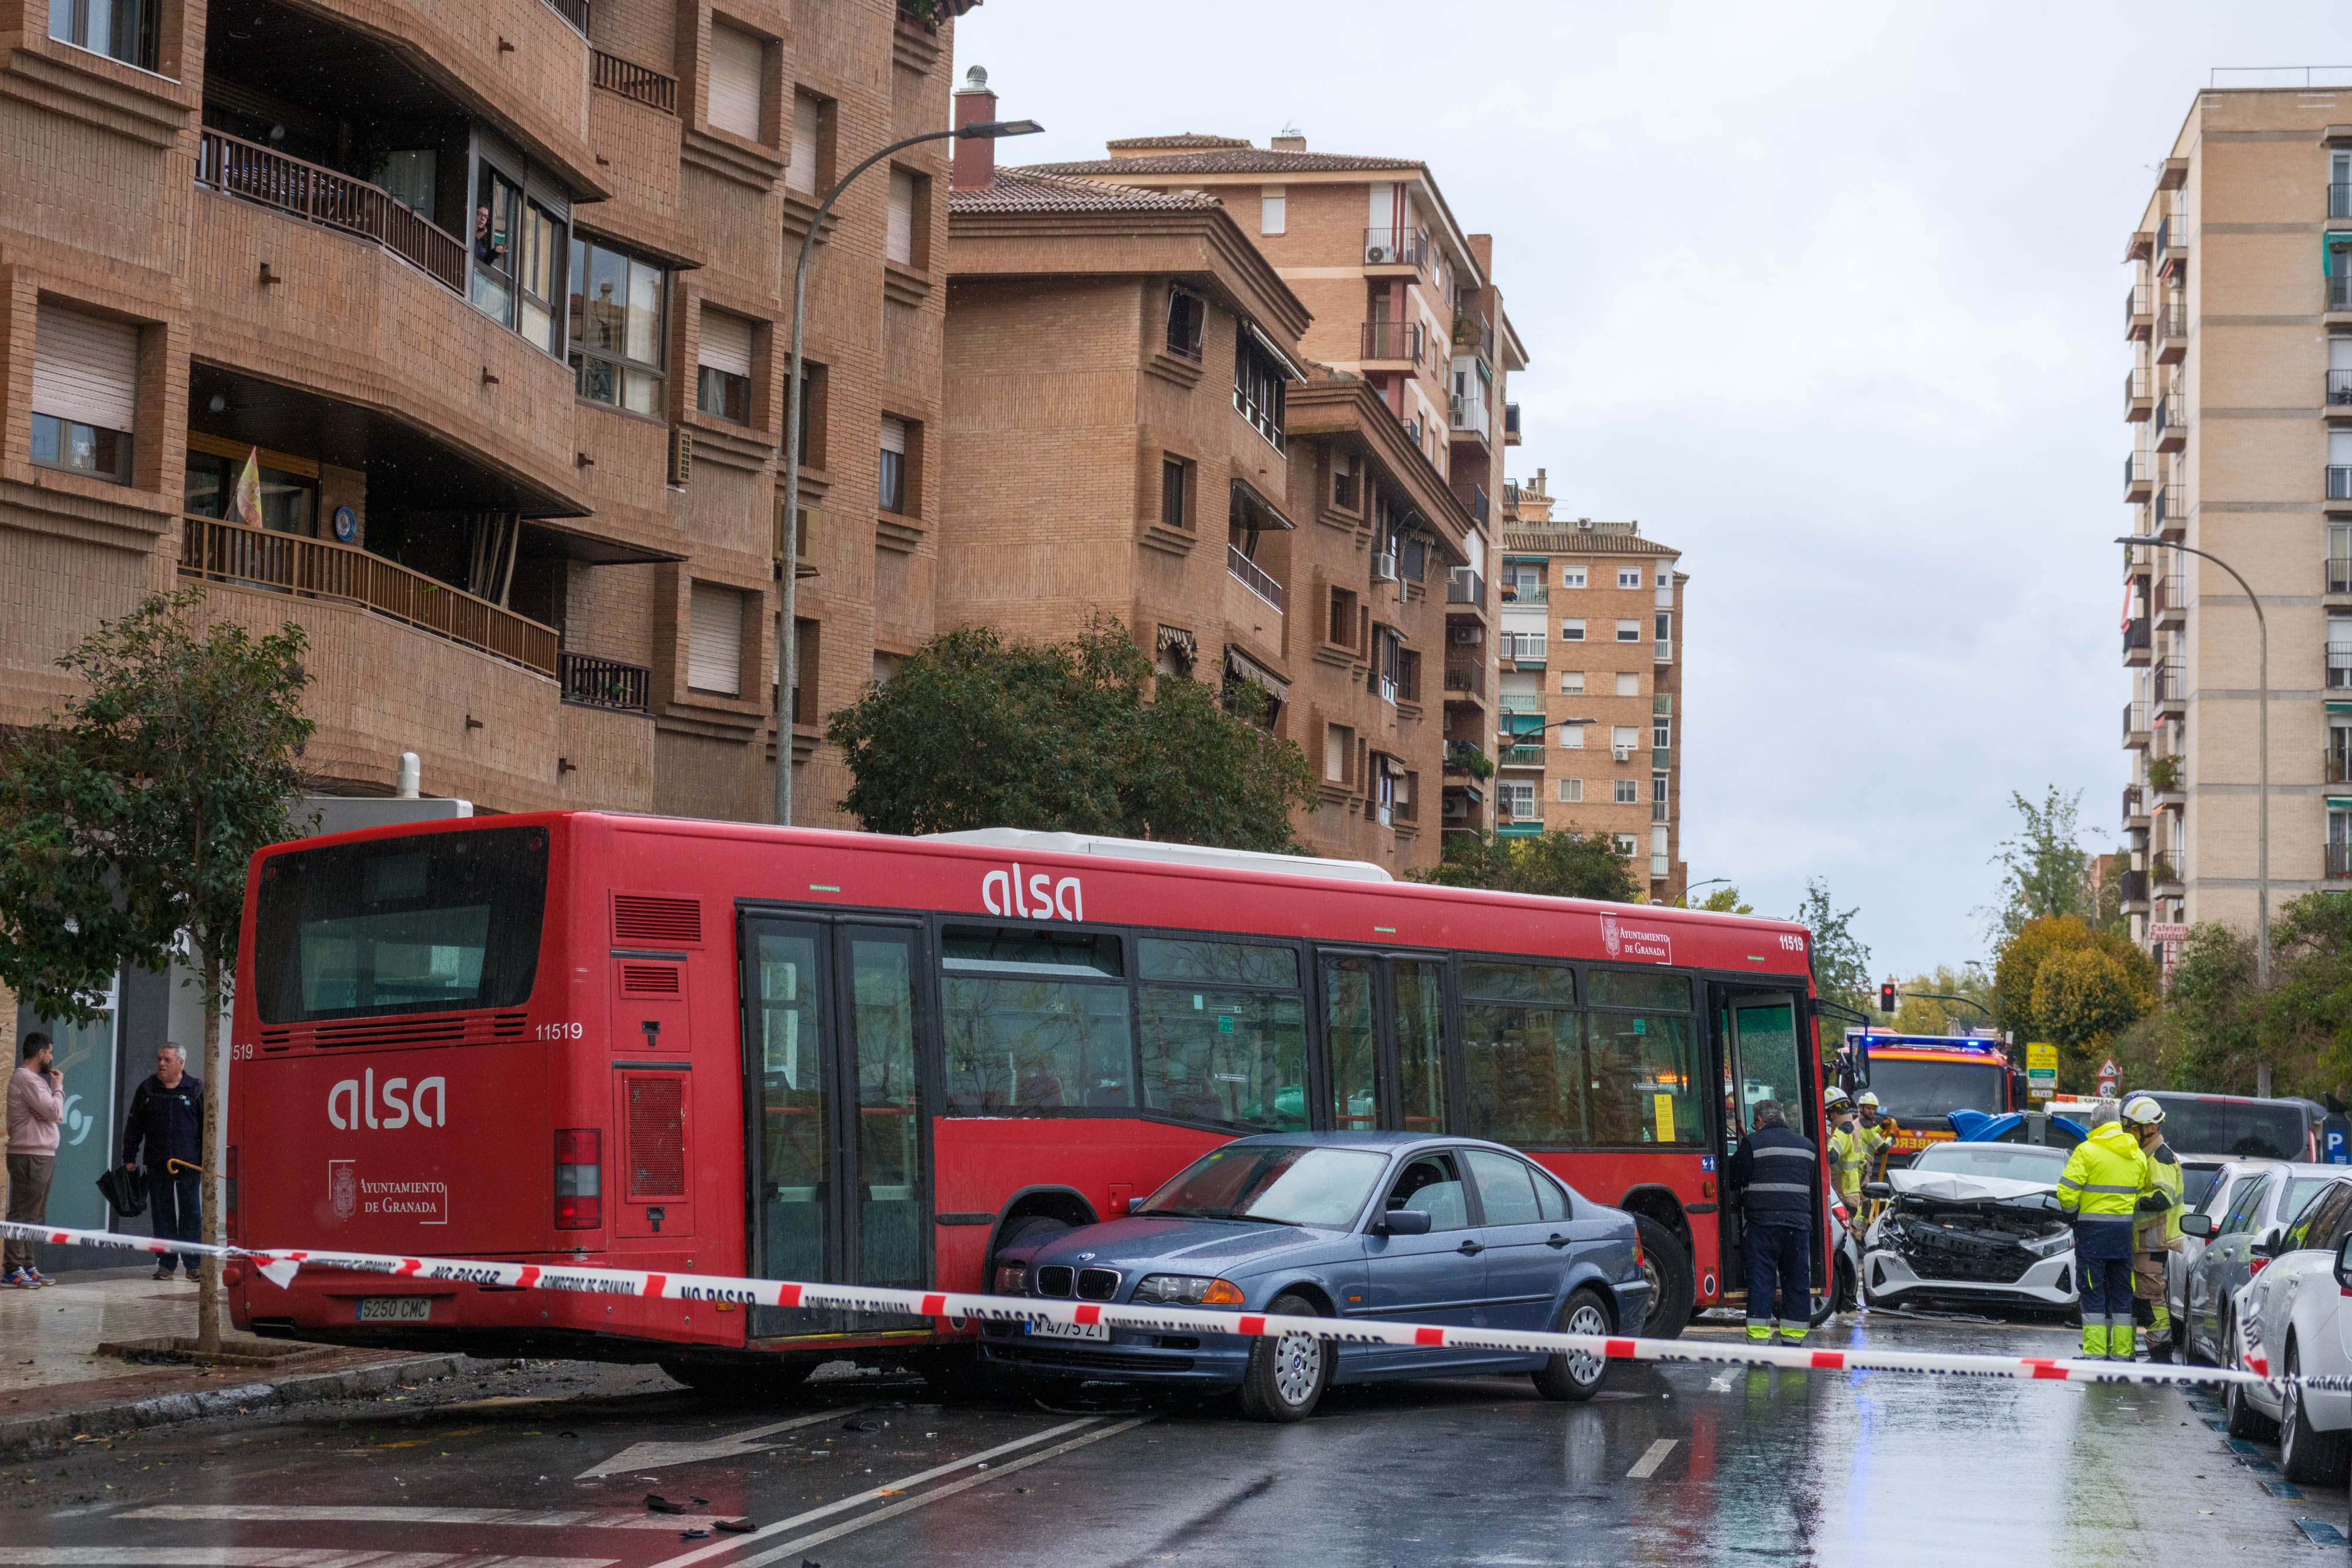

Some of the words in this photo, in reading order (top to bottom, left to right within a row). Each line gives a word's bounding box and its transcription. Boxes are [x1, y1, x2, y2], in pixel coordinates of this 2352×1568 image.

[982, 862, 1083, 922] alsa
[1779, 934, 1803, 951] 11519
[536, 1022, 583, 1040] 11519
[328, 1067, 446, 1130] alsa
[2328, 1133, 2343, 1151] P
[363, 1300, 397, 1318] 5250
[401, 1300, 427, 1318] CMC
